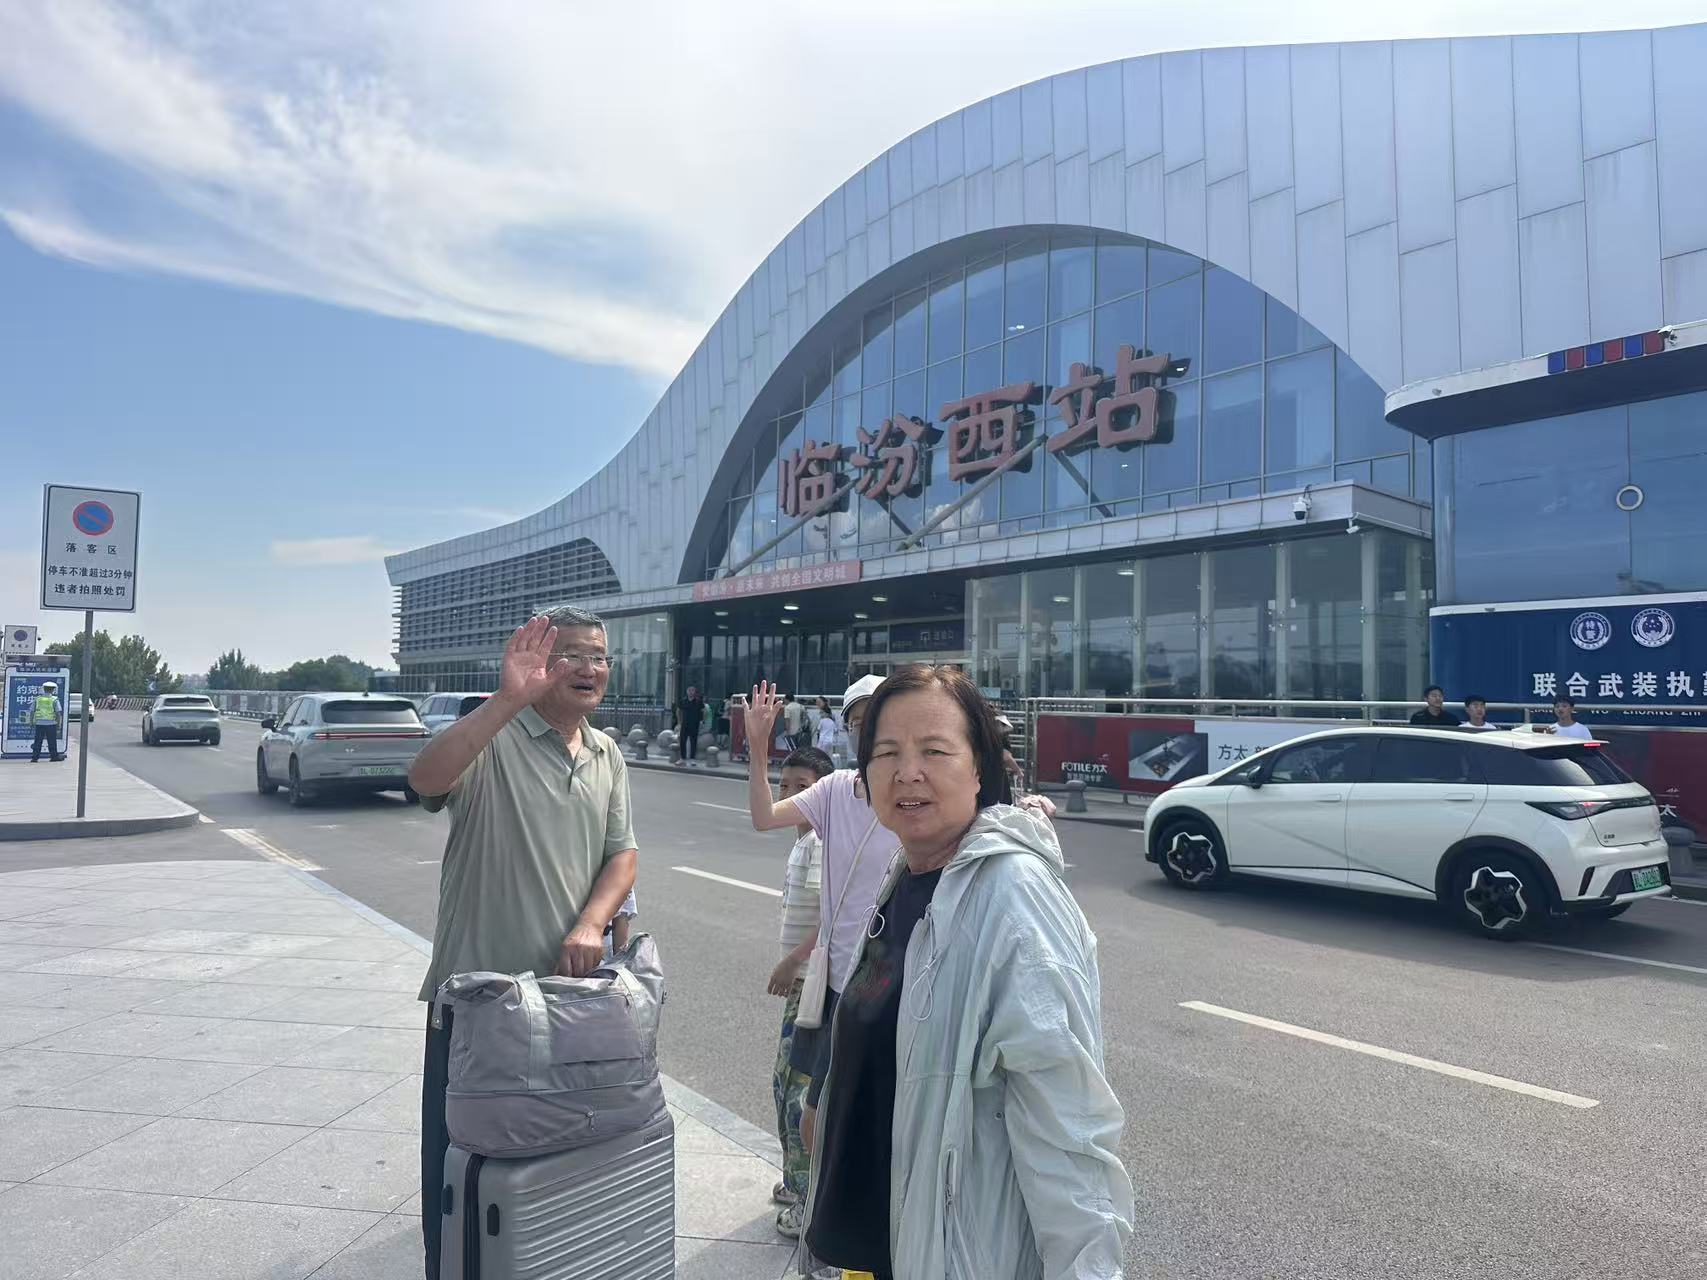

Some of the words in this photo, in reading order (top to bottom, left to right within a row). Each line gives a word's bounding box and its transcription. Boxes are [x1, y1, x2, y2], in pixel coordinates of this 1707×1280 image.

[780, 343, 1170, 517] 临汾西站
[66, 542, 117, 554] 落客区
[48, 565, 132, 580] 停车不准超过3分钟
[54, 583, 126, 597] 违者拍照处罚
[1533, 671, 1707, 698] 联合武装执
[1217, 744, 1249, 760] 方太
